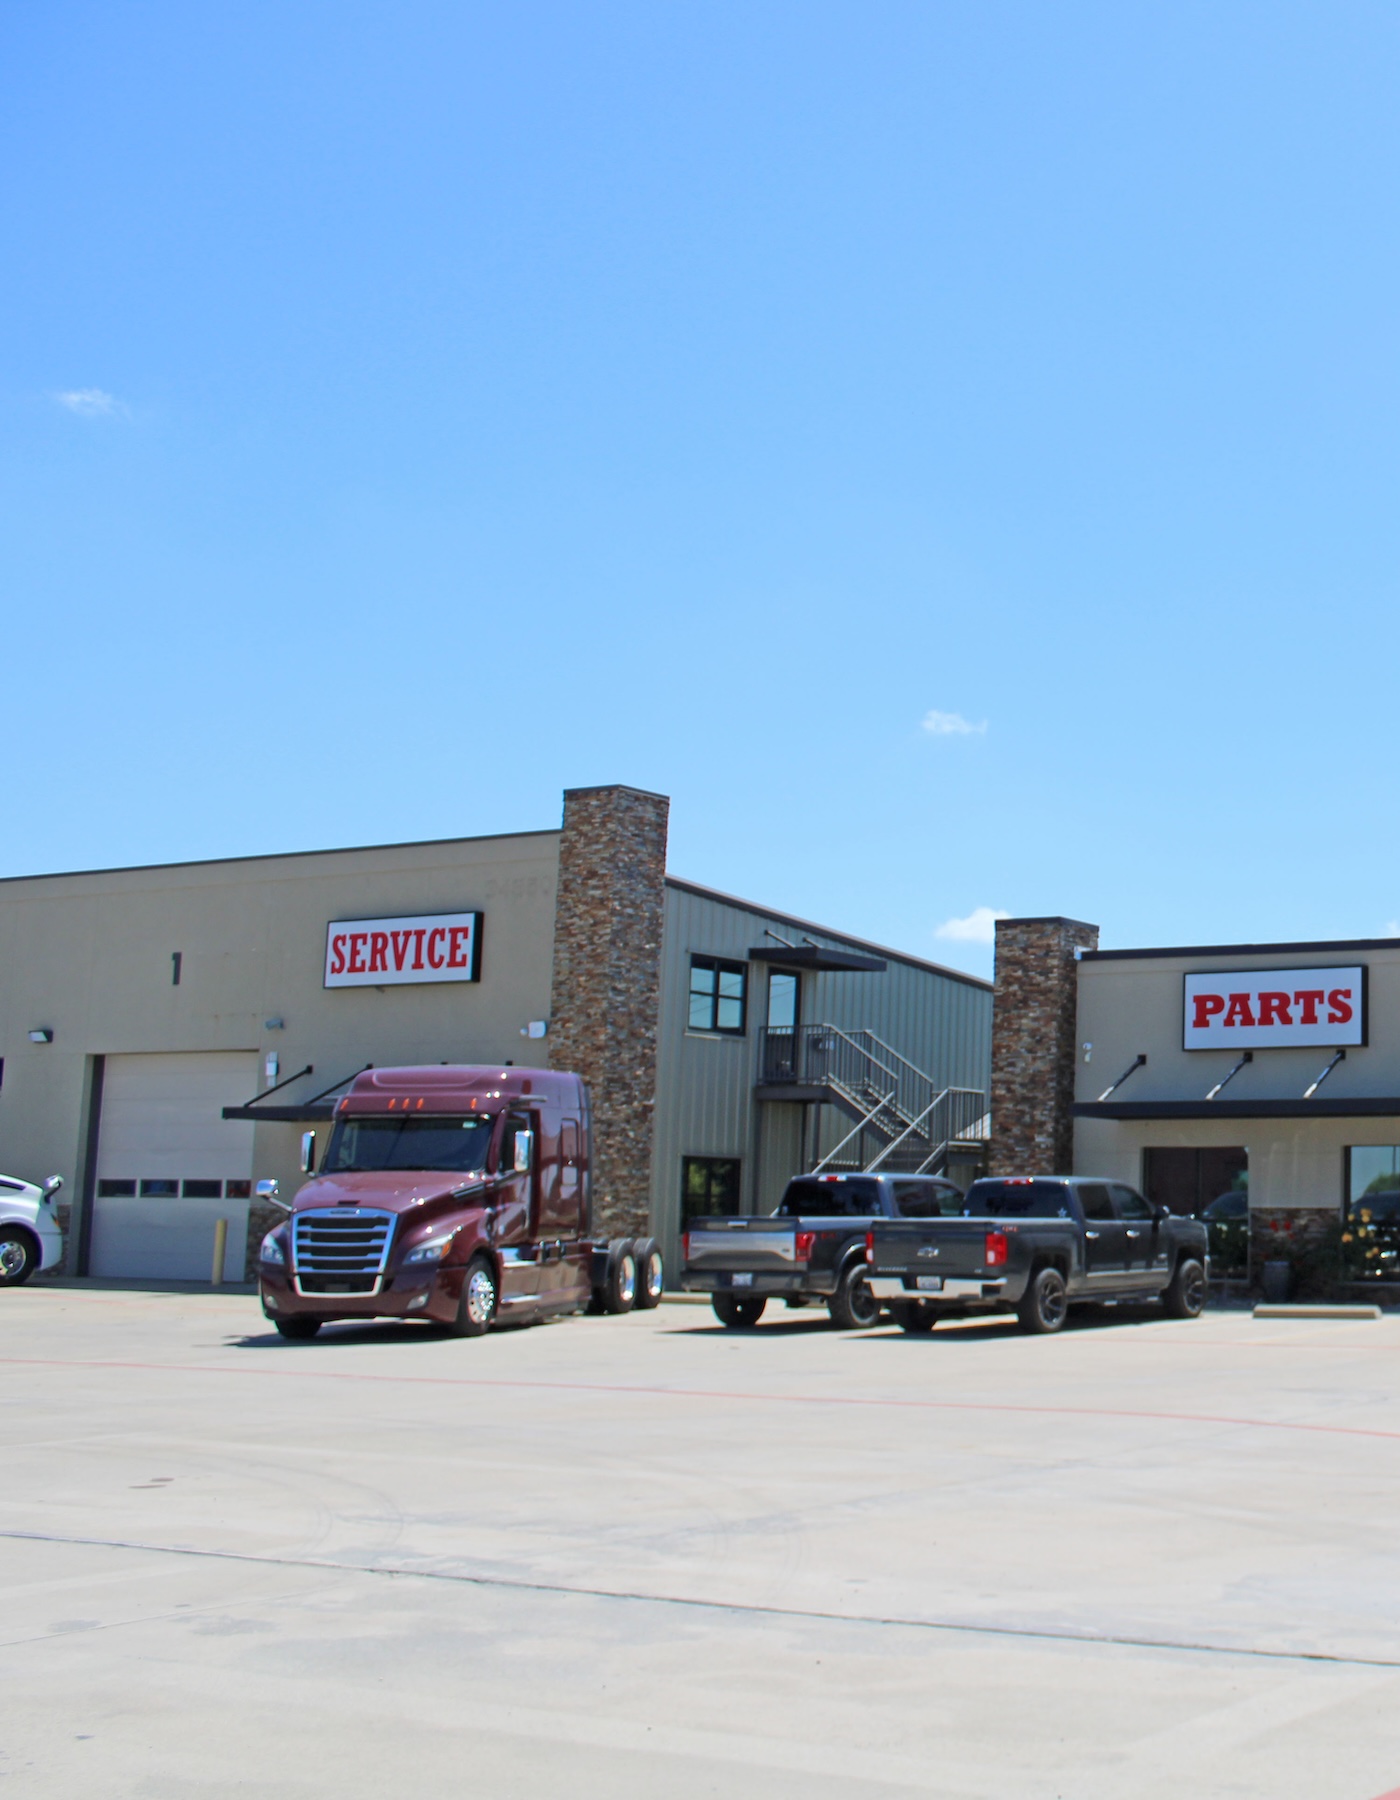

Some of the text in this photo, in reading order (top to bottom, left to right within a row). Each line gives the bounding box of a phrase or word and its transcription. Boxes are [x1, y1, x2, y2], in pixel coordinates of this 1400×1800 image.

[172, 951, 182, 985] 1
[330, 926, 470, 974] SERVICE
[1192, 988, 1353, 1028] PARTS
